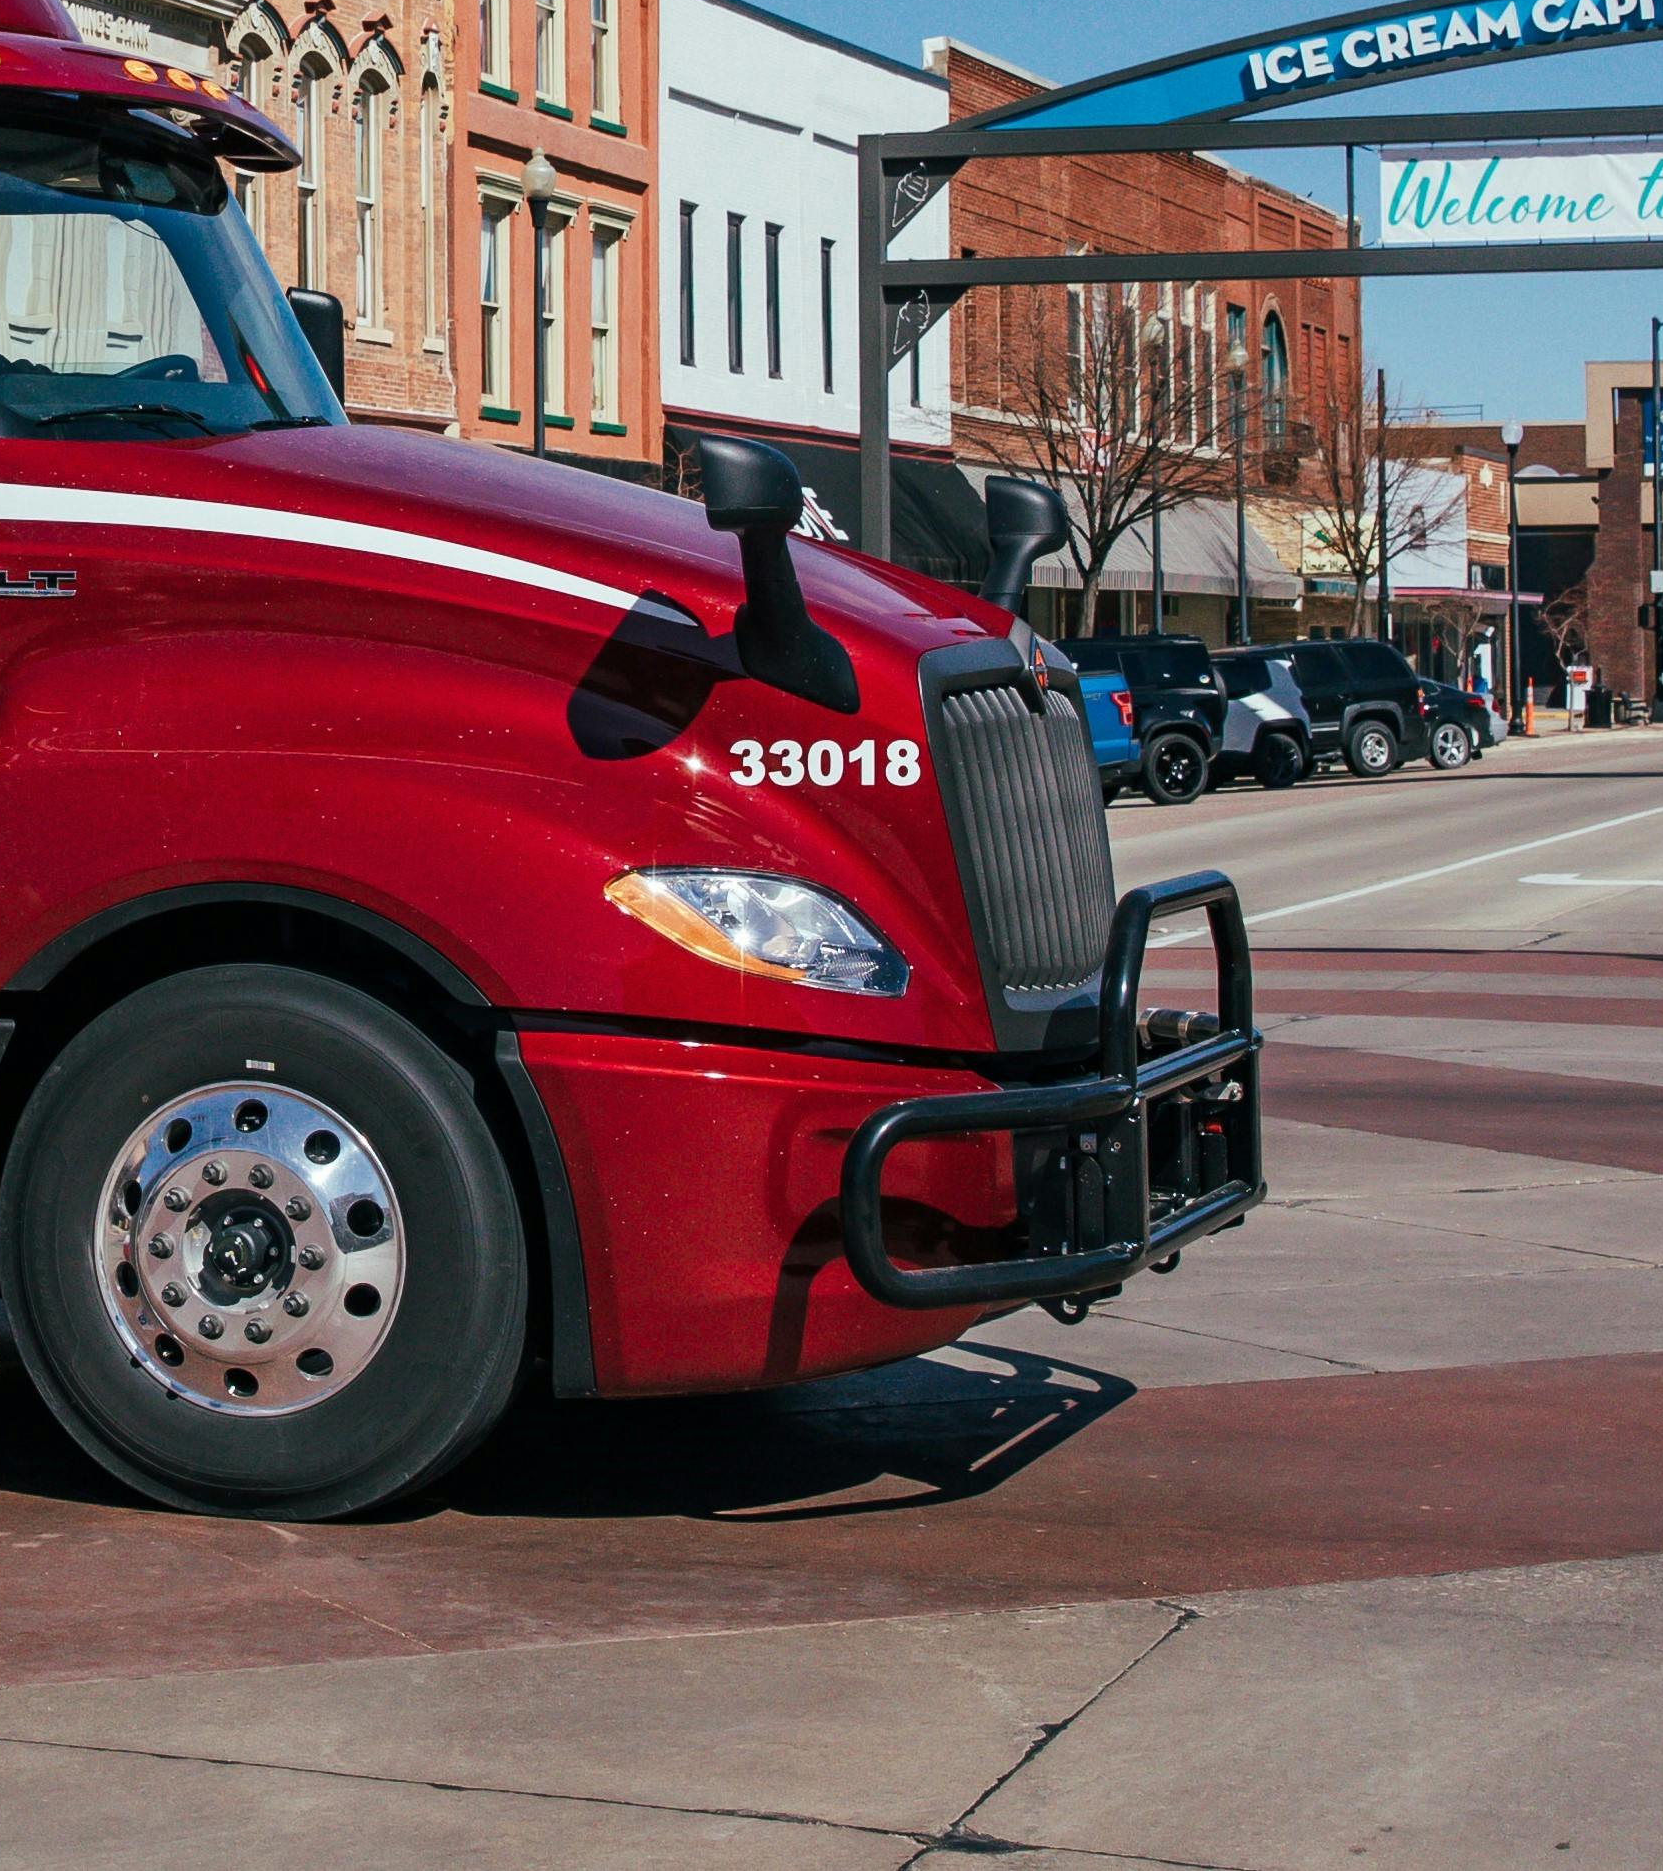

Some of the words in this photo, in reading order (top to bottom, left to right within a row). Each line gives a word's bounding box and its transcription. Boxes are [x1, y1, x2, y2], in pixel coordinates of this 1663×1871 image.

[1247, 38, 1334, 90] ICE
[1342, 1, 1521, 69] CREAM
[1389, 157, 1614, 229] Welcome
[729, 740, 921, 786] 33018
